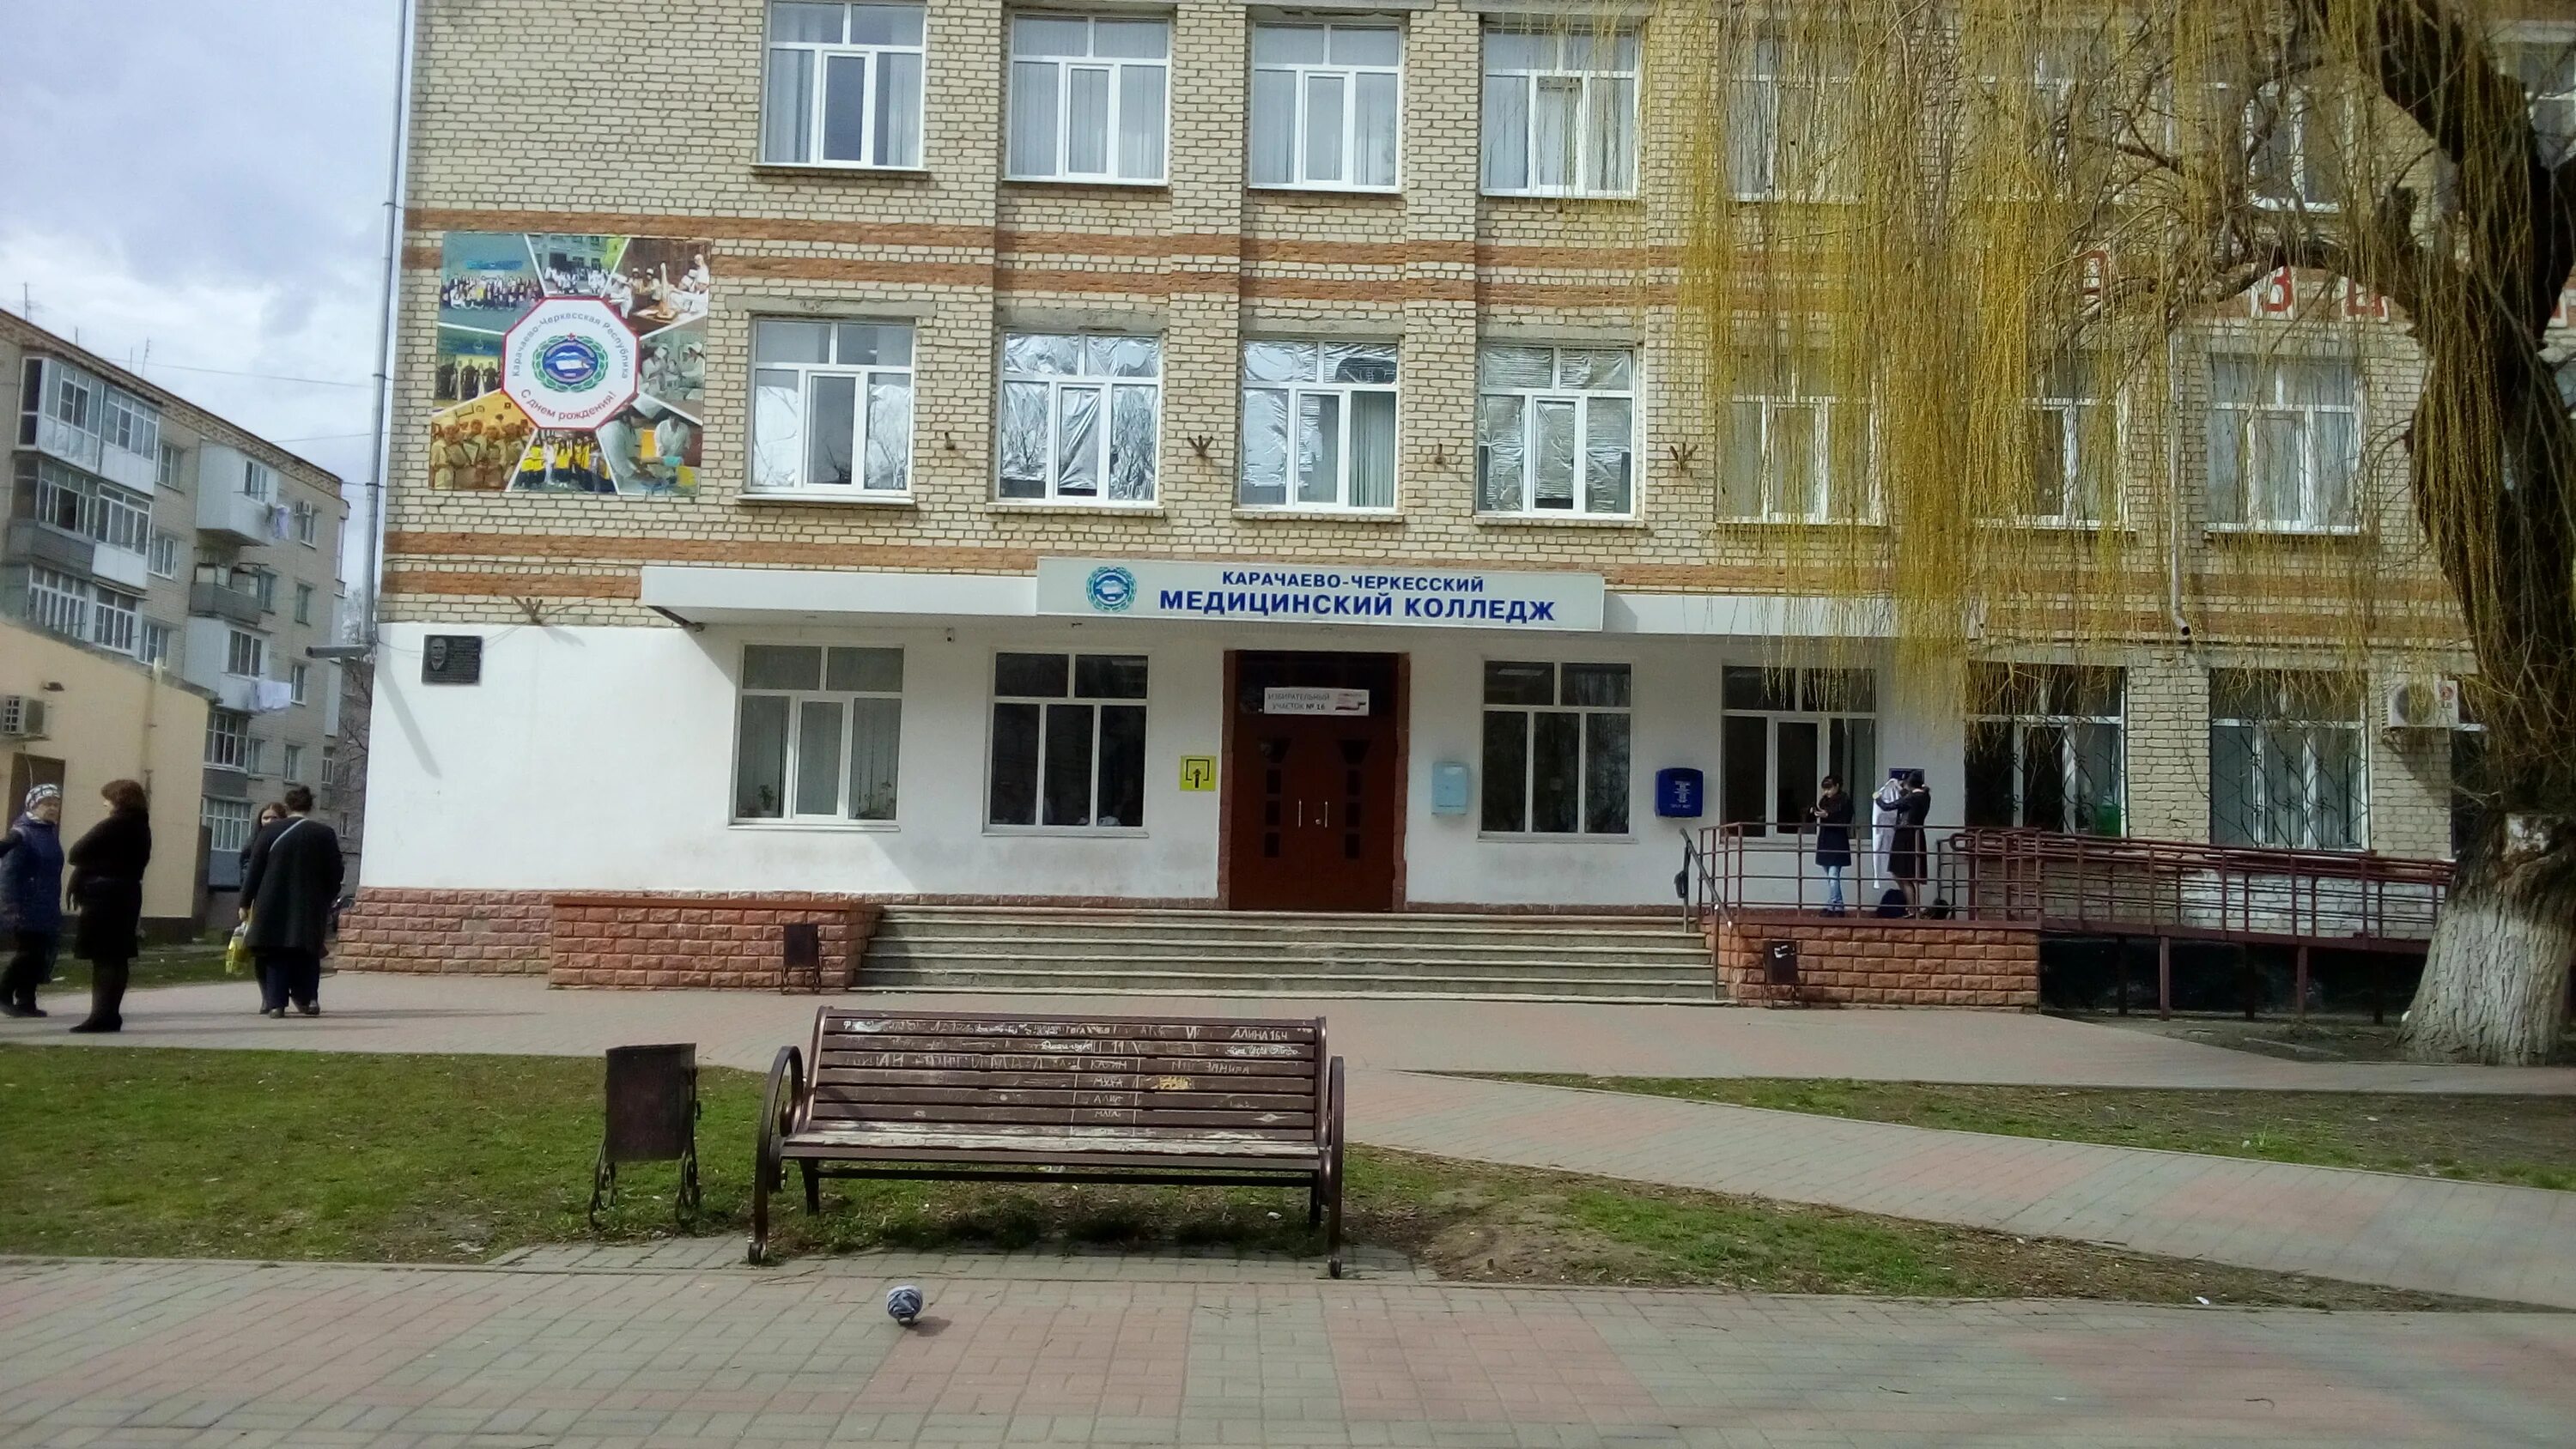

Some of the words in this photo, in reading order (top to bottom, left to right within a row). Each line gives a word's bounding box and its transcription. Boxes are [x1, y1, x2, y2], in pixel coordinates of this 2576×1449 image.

[513, 312, 601, 377] Карачаево-Черкесская
[602, 321, 629, 379] Республика
[520, 389, 532, 398] С
[526, 399, 556, 418] днем
[558, 391, 617, 421] рождения!
[1222, 571, 1484, 592] КАРАЧАЕВО-ЧЕРКЕССКИЙ
[1159, 590, 1393, 616] МЕДИЦИНСКИЙ
[1404, 597, 1556, 624] КОЛЛЕДЖ
